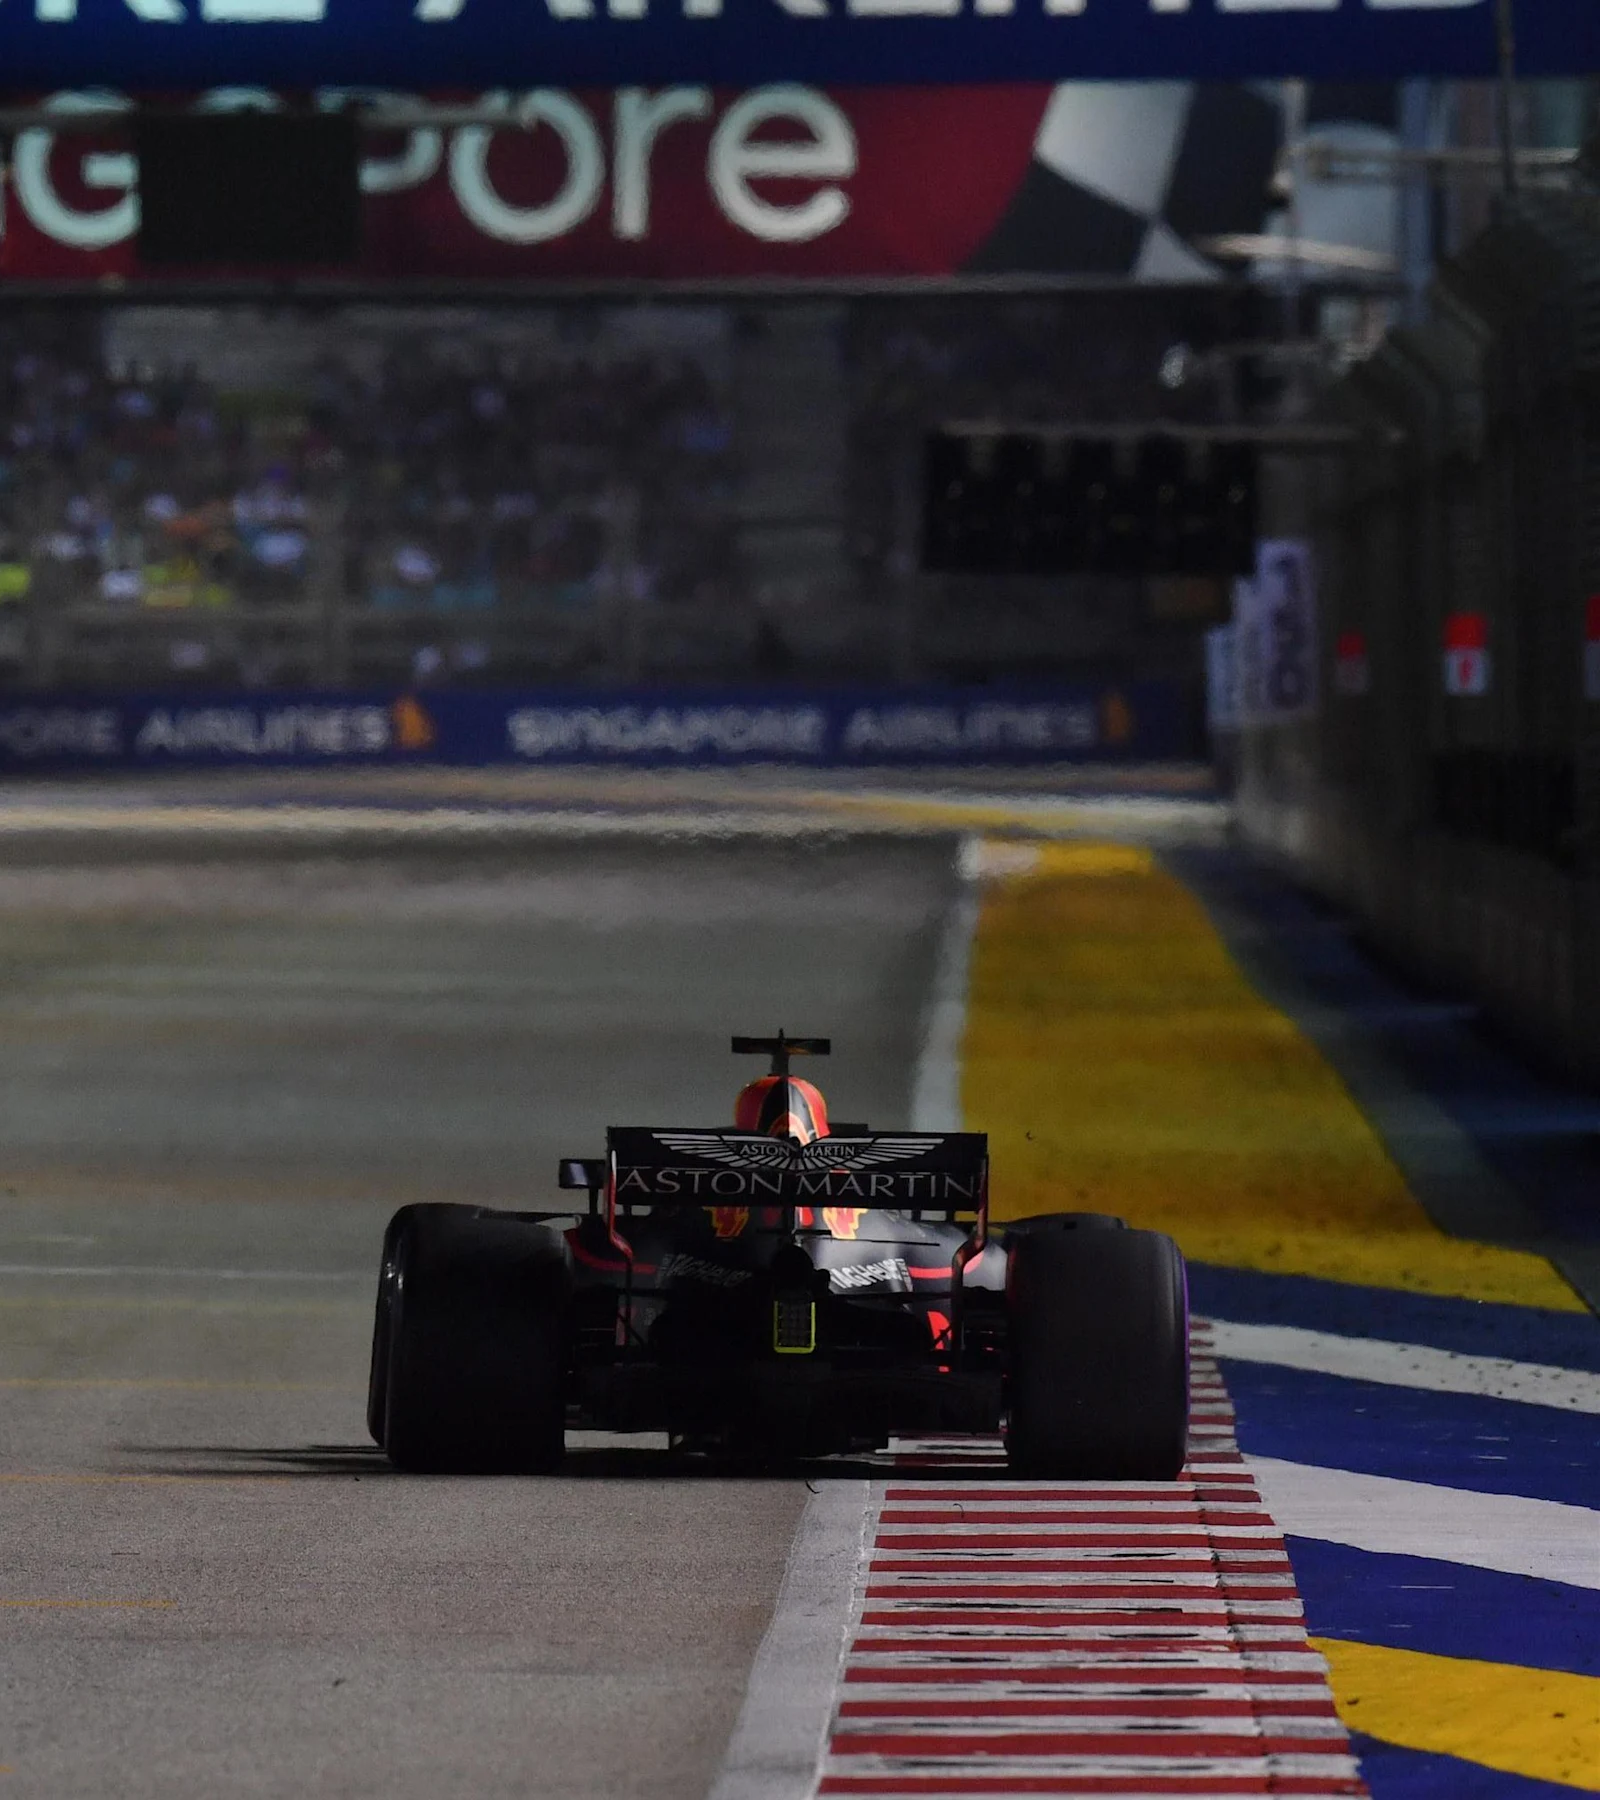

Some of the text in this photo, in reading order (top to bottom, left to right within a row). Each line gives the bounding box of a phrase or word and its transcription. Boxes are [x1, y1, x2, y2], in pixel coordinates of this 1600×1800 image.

[135, 705, 391, 753] AIRLINES
[505, 707, 827, 756] SINGAPORE
[739, 1143, 856, 1159] ASTON MARTIN
[617, 1168, 976, 1198] ASTON MARTIN
